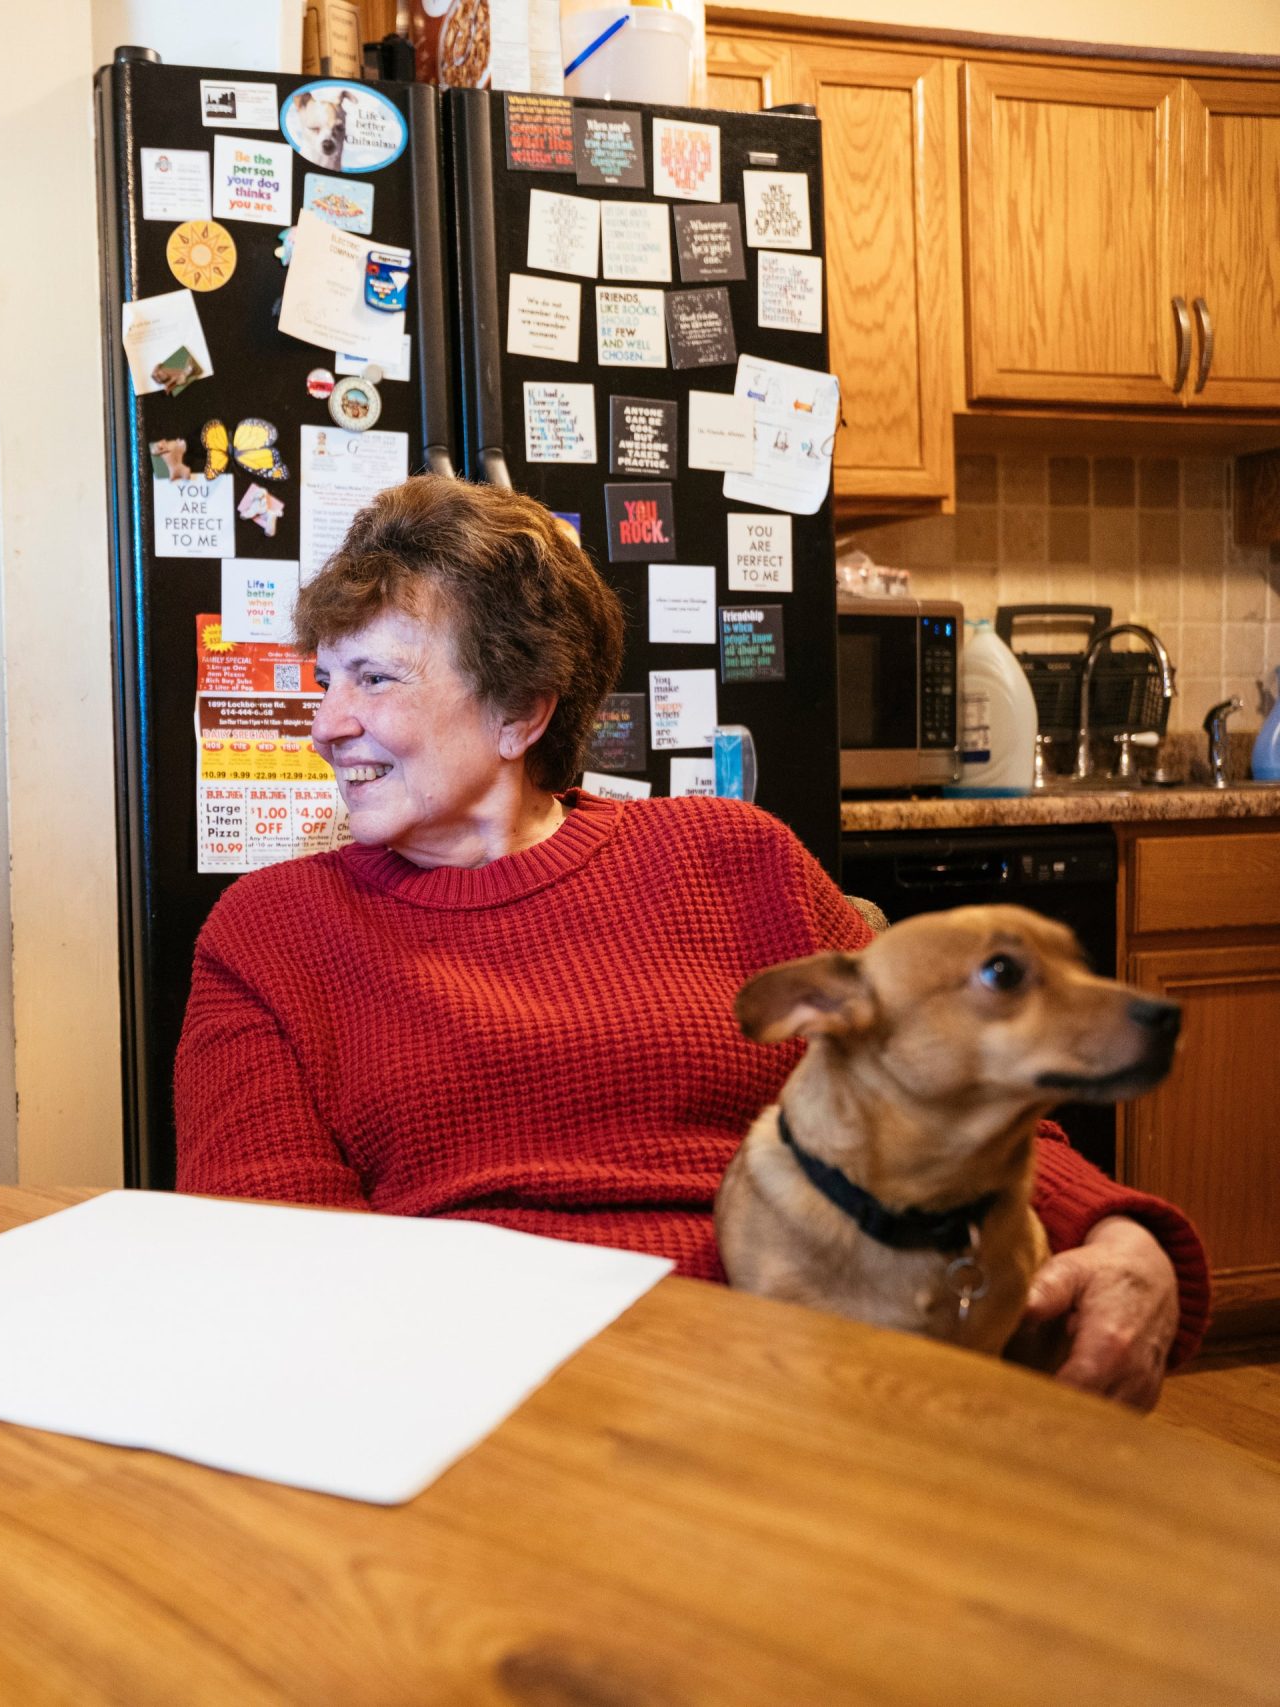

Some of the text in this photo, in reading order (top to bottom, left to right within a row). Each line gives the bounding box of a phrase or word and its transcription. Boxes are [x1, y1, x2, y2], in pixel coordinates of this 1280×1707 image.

[356, 120, 386, 132] better
[234, 151, 273, 166] Be the
[233, 164, 275, 177] person
[227, 175, 280, 192] your dog
[235, 187, 271, 201] thinks
[228, 198, 277, 212] you are.
[600, 291, 641, 305] FRIENDS,
[600, 304, 619, 314] LIKE
[615, 328, 636, 337] FEW
[601, 339, 651, 350] AND WELL
[624, 406, 664, 418] ANYONE
[625, 415, 646, 424] CAN
[619, 440, 669, 452] AWESOME
[617, 457, 670, 469] PRACTICE.
[177, 485, 210, 498] YOU
[181, 502, 207, 514] ARE
[624, 500, 658, 522] YOU
[165, 518, 223, 531] PERFECT
[619, 520, 670, 544] ROCK.
[746, 525, 773, 537] YOU
[172, 534, 218, 547] TO ME
[749, 541, 771, 552] ARE
[737, 555, 783, 567] PERFECT
[742, 570, 779, 582] TO ME
[247, 580, 275, 589] Life is
[246, 589, 275, 598] better
[247, 607, 275, 616] you're
[732, 623, 754, 633] when
[226, 656, 253, 664] SPECIAL
[654, 685, 680, 693] make
[274, 701, 286, 709] Rd.
[655, 710, 680, 718] when
[655, 728, 670, 736] are
[685, 788, 708, 796] never
[206, 803, 241, 814] Large
[251, 807, 288, 819] $1.00
[296, 807, 333, 819] $4.00
[206, 816, 242, 825] 1-Item
[208, 828, 240, 838] Pizza
[255, 822, 283, 834] OFF
[301, 822, 327, 834] OFF
[205, 843, 243, 853] $10.99
